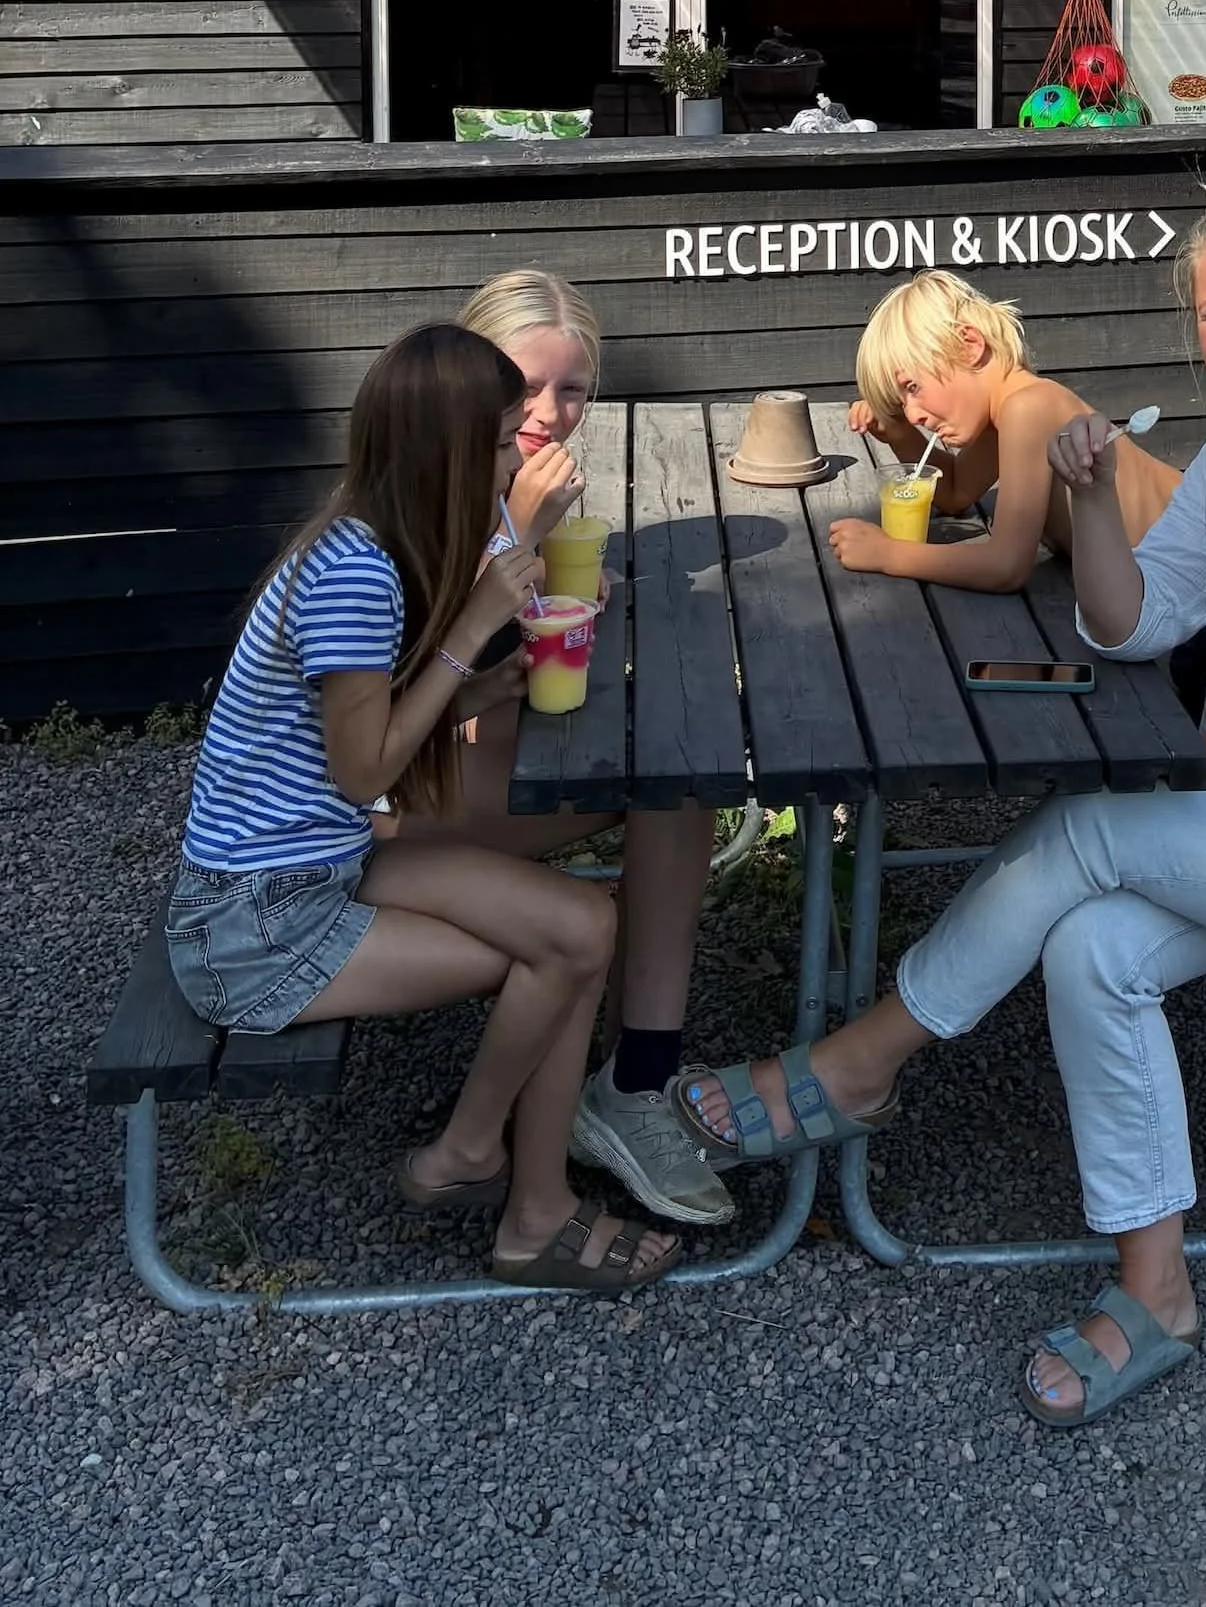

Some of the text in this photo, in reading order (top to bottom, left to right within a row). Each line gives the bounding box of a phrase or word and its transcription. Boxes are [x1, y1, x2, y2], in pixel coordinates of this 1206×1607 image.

[665, 212, 1135, 277] RECEPTION & KIOSK
